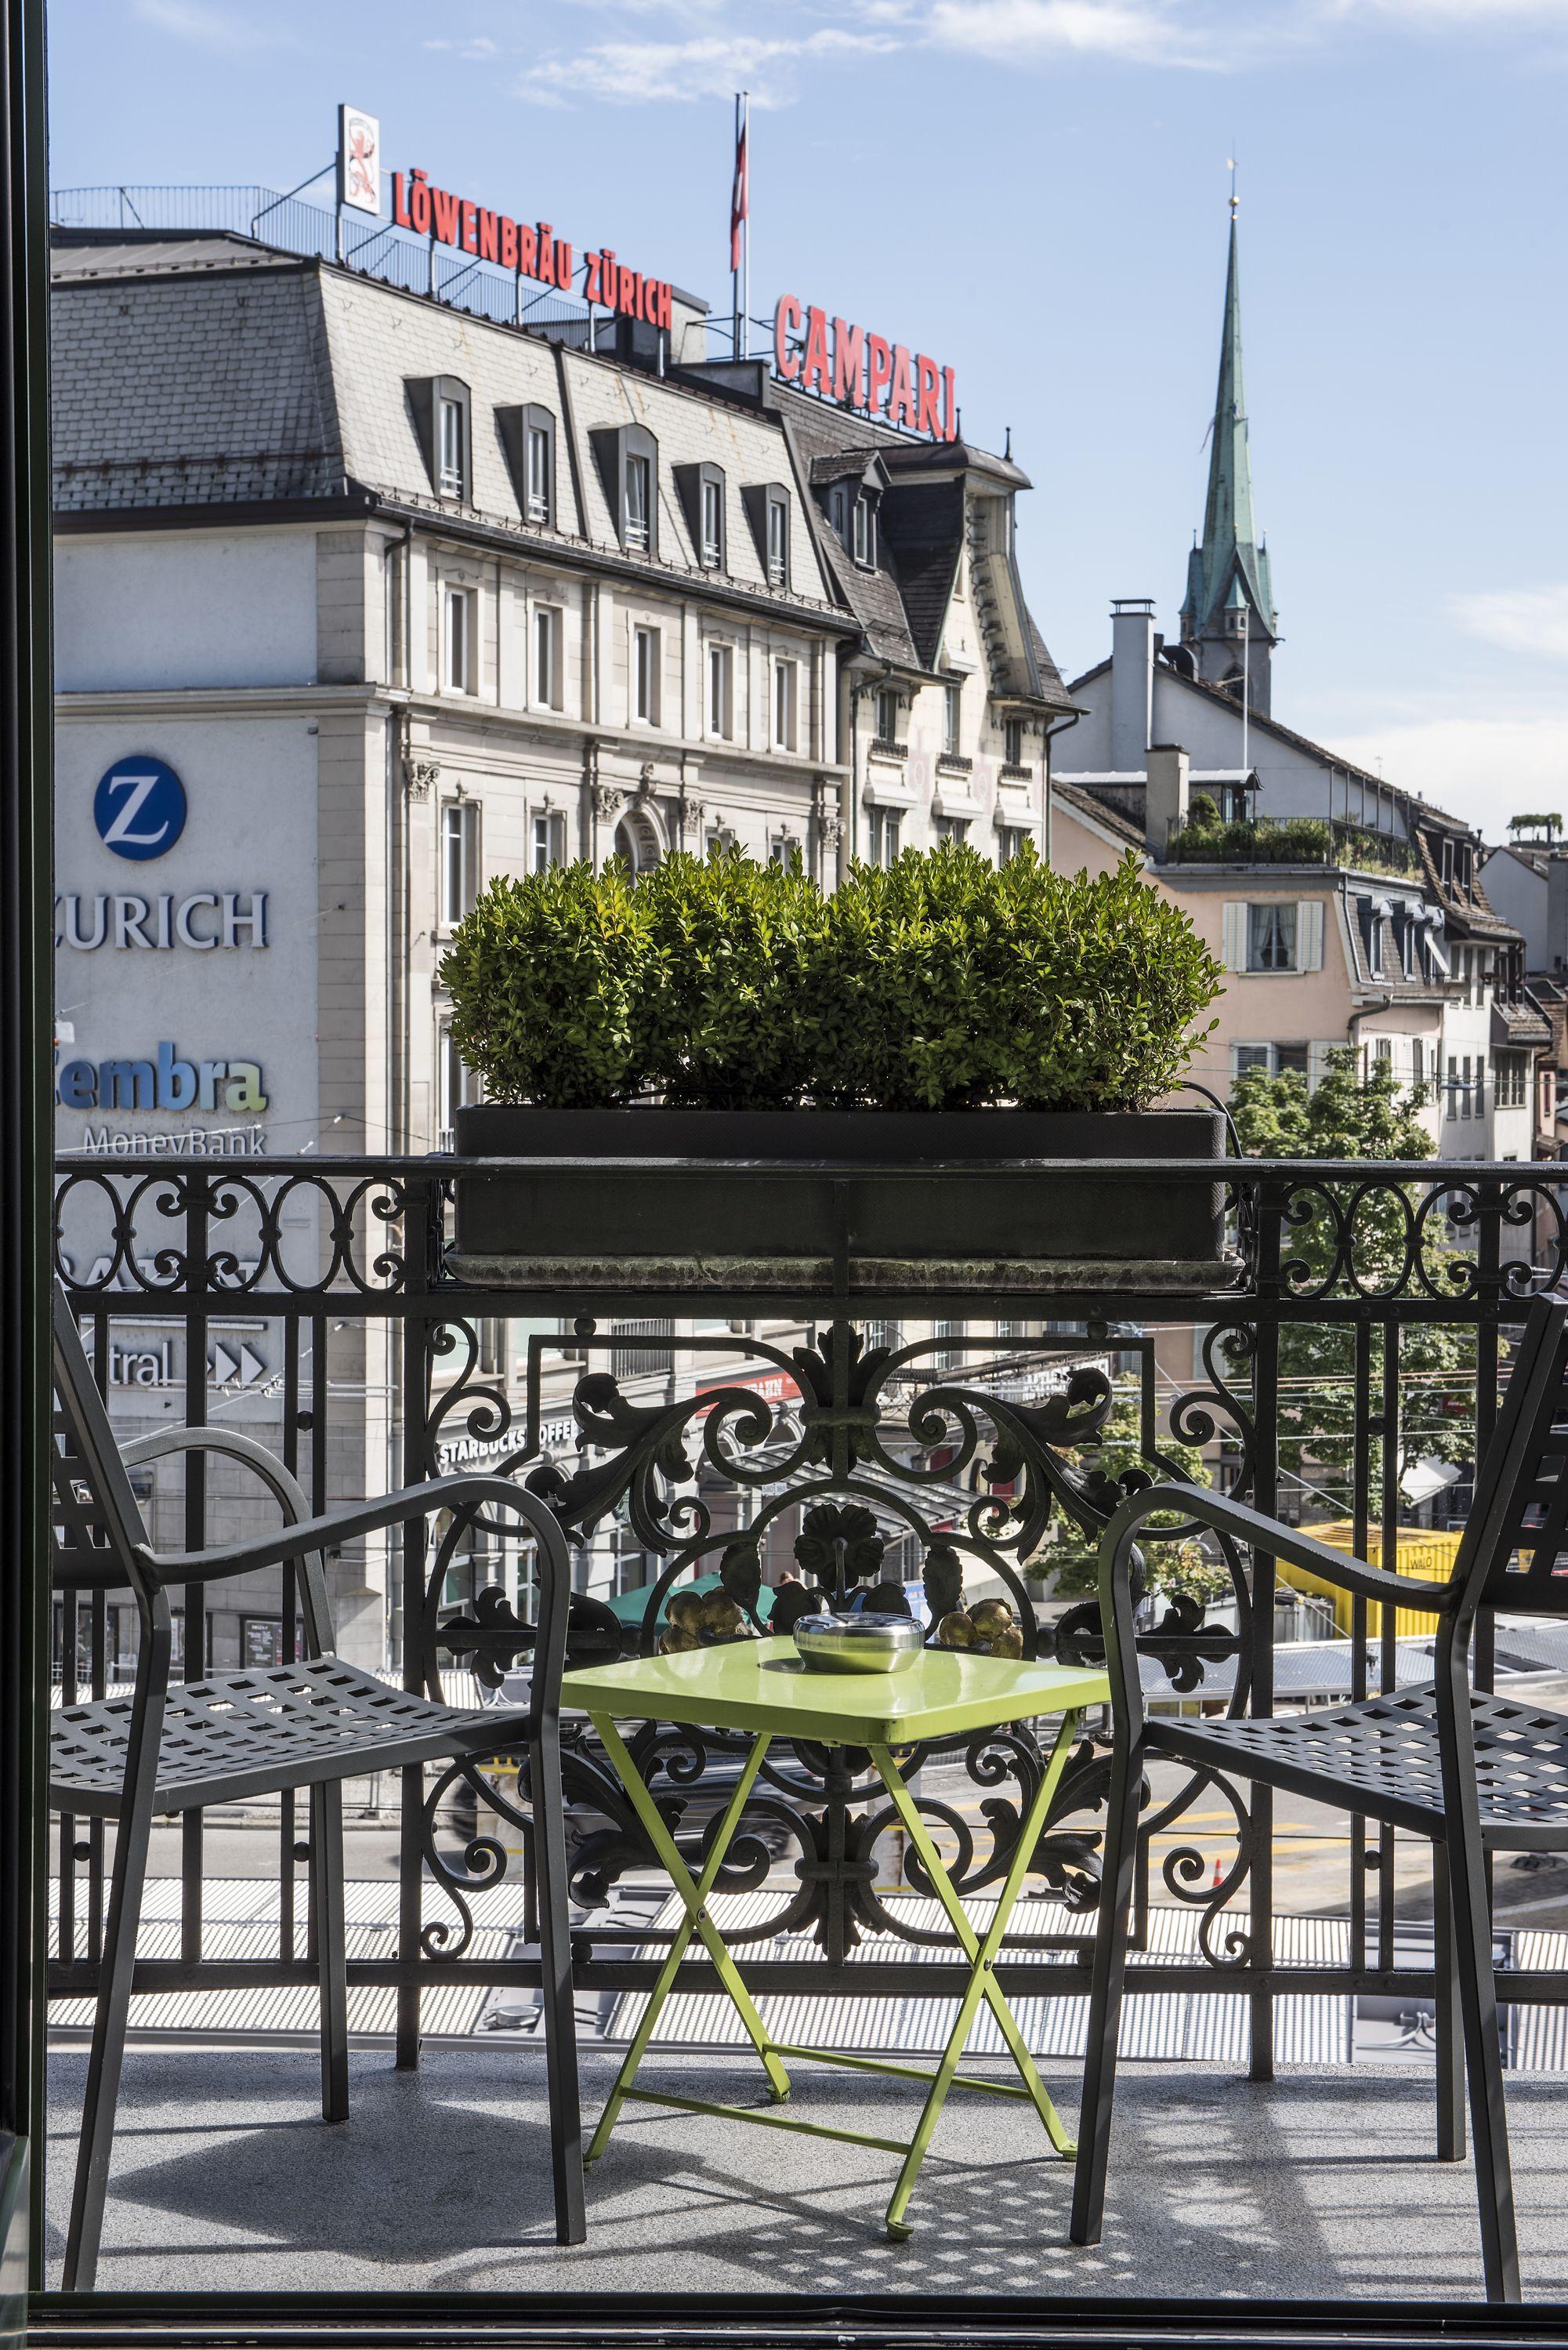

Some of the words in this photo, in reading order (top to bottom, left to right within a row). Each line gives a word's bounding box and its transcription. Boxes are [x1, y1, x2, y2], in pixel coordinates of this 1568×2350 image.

[392, 169, 572, 290] LÖWENBRÄU
[584, 248, 672, 330] ZÜRICH
[774, 294, 956, 442] CAMPARI
[56, 894, 269, 949] URICH
[56, 1041, 269, 1112] embra
[440, 1430, 526, 1464] STARBUCKS
[539, 1420, 578, 1445] OFFEE
[1410, 1556, 1432, 1569] WALO
